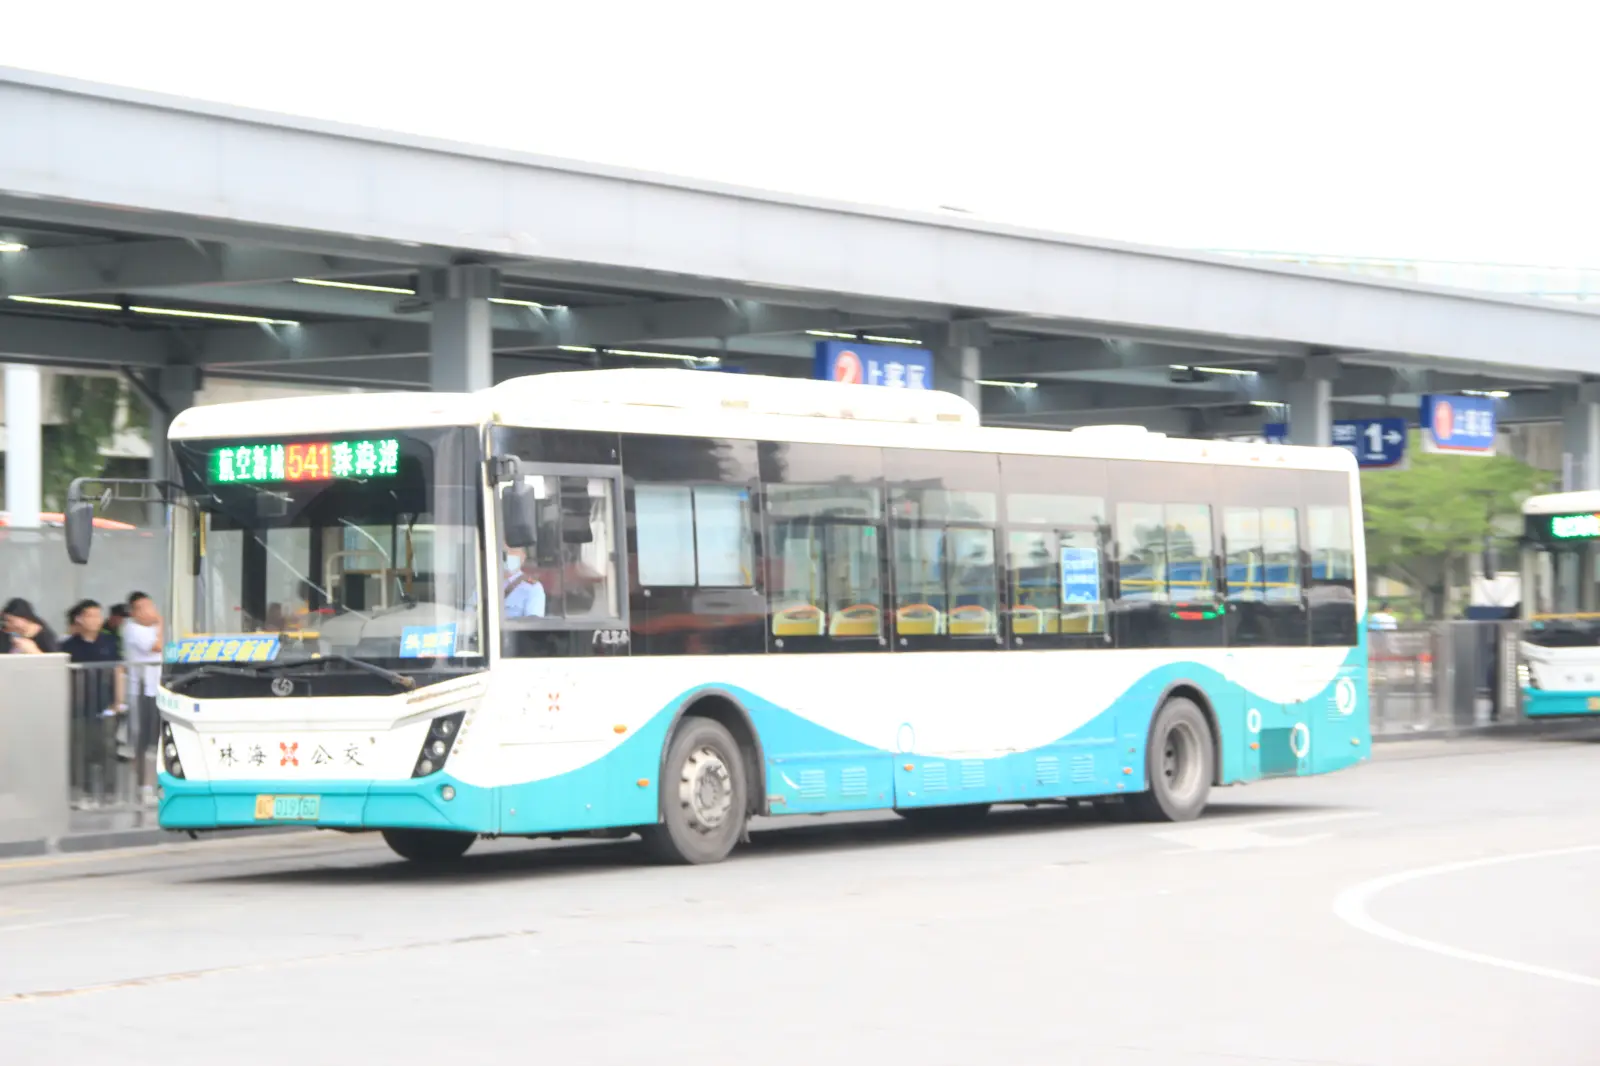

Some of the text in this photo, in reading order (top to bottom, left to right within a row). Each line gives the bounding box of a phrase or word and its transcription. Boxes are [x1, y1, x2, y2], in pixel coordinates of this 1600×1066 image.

[1364, 422, 1383, 453] 1
[288, 445, 330, 478] 541
[311, 743, 364, 766] 公交
